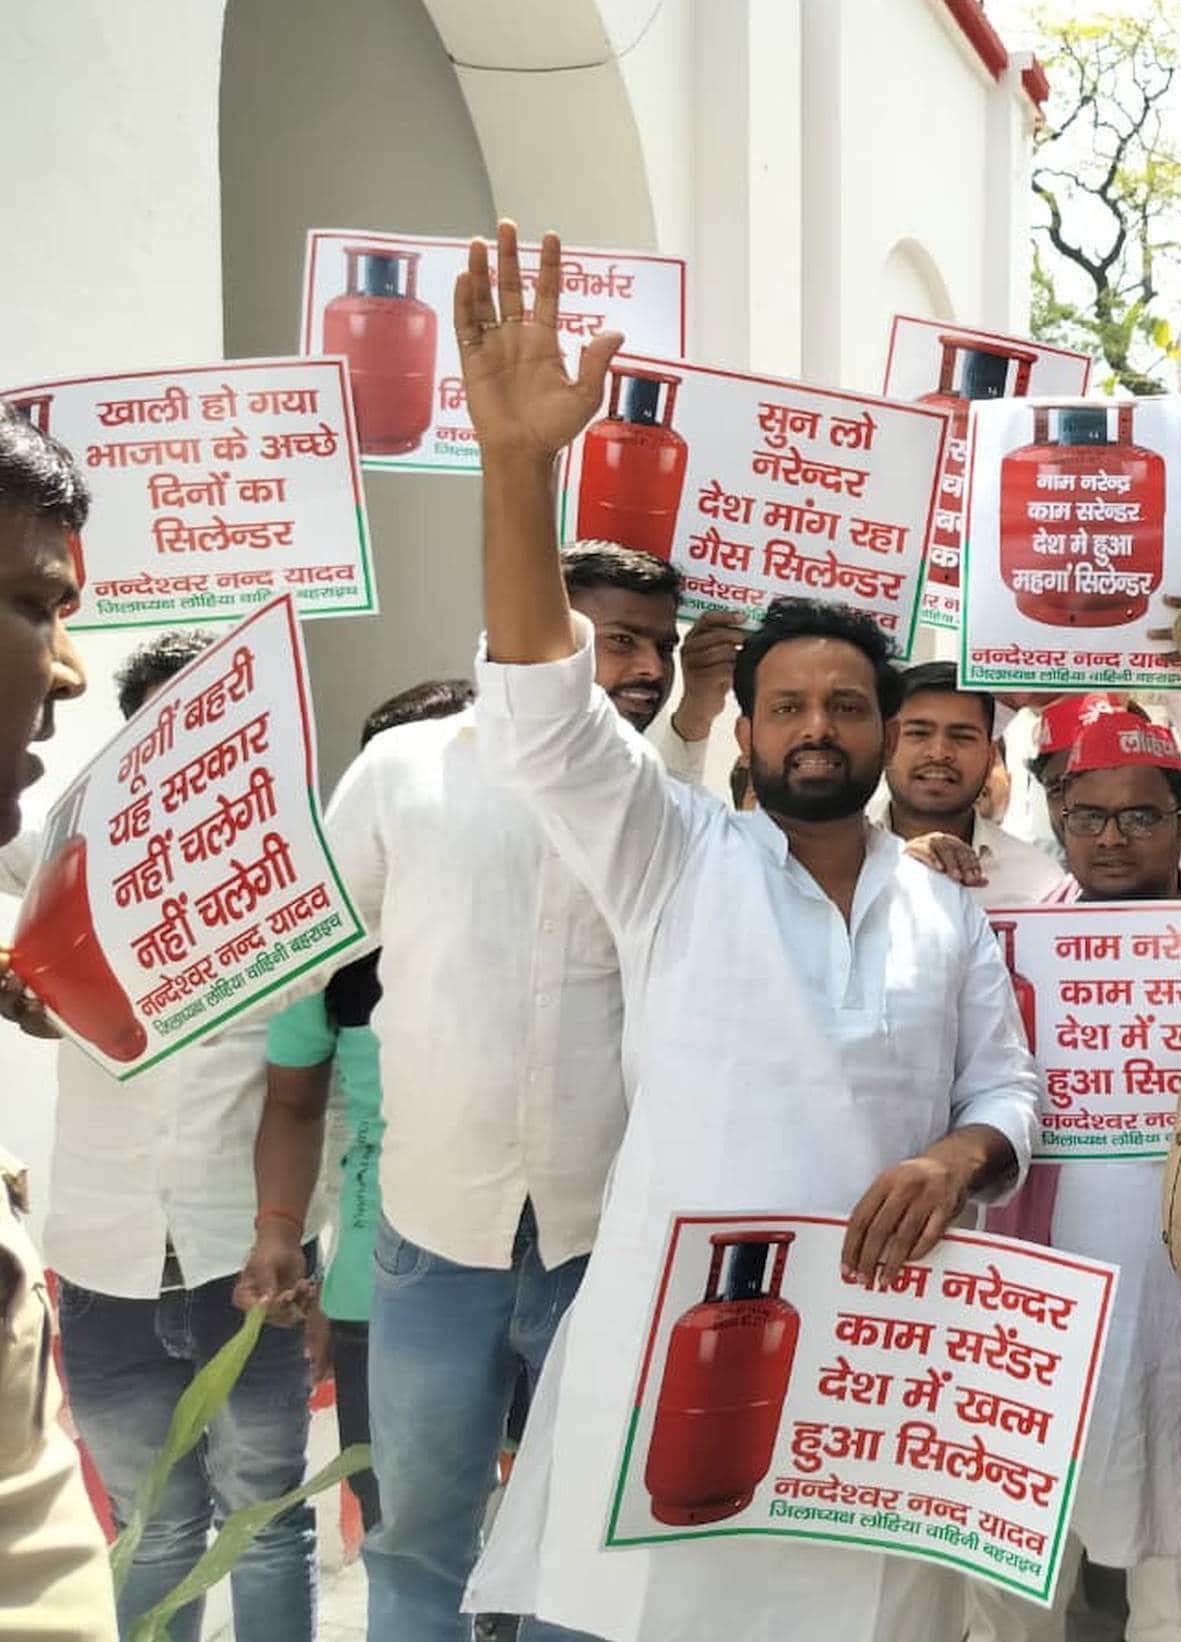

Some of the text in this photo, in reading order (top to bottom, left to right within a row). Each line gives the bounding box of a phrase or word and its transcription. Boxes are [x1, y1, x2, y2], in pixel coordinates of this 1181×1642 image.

[96, 384, 317, 426] खाली हो गया
[758, 402, 876, 450] सुन लो
[86, 422, 337, 466] भाजपा के अच्छे
[148, 472, 284, 508] दिनों का
[752, 446, 868, 496] नरेन्दर
[1036, 474, 1075, 491] नाम
[698, 479, 754, 523] देश
[763, 497, 840, 539] मांग
[850, 518, 907, 554] रहा
[1026, 502, 1070, 521] काम
[151, 516, 294, 552] सिलेन्डर
[1032, 527, 1065, 554] देश
[1093, 533, 1132, 566] हुआ
[92, 564, 353, 597] नन्देश्वर नन्द यादव
[689, 525, 752, 571] गैस
[763, 539, 905, 600] सिलेन्डर
[1074, 561, 1152, 596] सिलेन्डर
[971, 643, 1066, 666] नन्देश्वर
[1073, 651, 1120, 669] नन्द
[183, 646, 252, 730] बहरी
[108, 710, 268, 845] यह सरकार
[112, 767, 275, 907] नहीं चलेगी
[130, 832, 295, 969] नहीं चलेगी
[214, 923, 265, 965] नन्द
[265, 881, 330, 934] यादव
[1055, 936, 1120, 960] नाम
[1059, 980, 1133, 1005] काम
[1056, 1014, 1108, 1049] देश
[1120, 1014, 1154, 1050] में
[1046, 1068, 1113, 1108] हुआ
[1041, 1108, 1136, 1129] नन्देश्वर
[942, 1264, 1076, 1330] नरेन्दर
[835, 1313, 1060, 1385] काम सरेंडर
[818, 1356, 1051, 1444] देश में खत्म
[791, 1421, 1057, 1507] हुआ सिलेन्डर
[773, 1473, 1047, 1555] नन्देश्वर नन्द यादव
